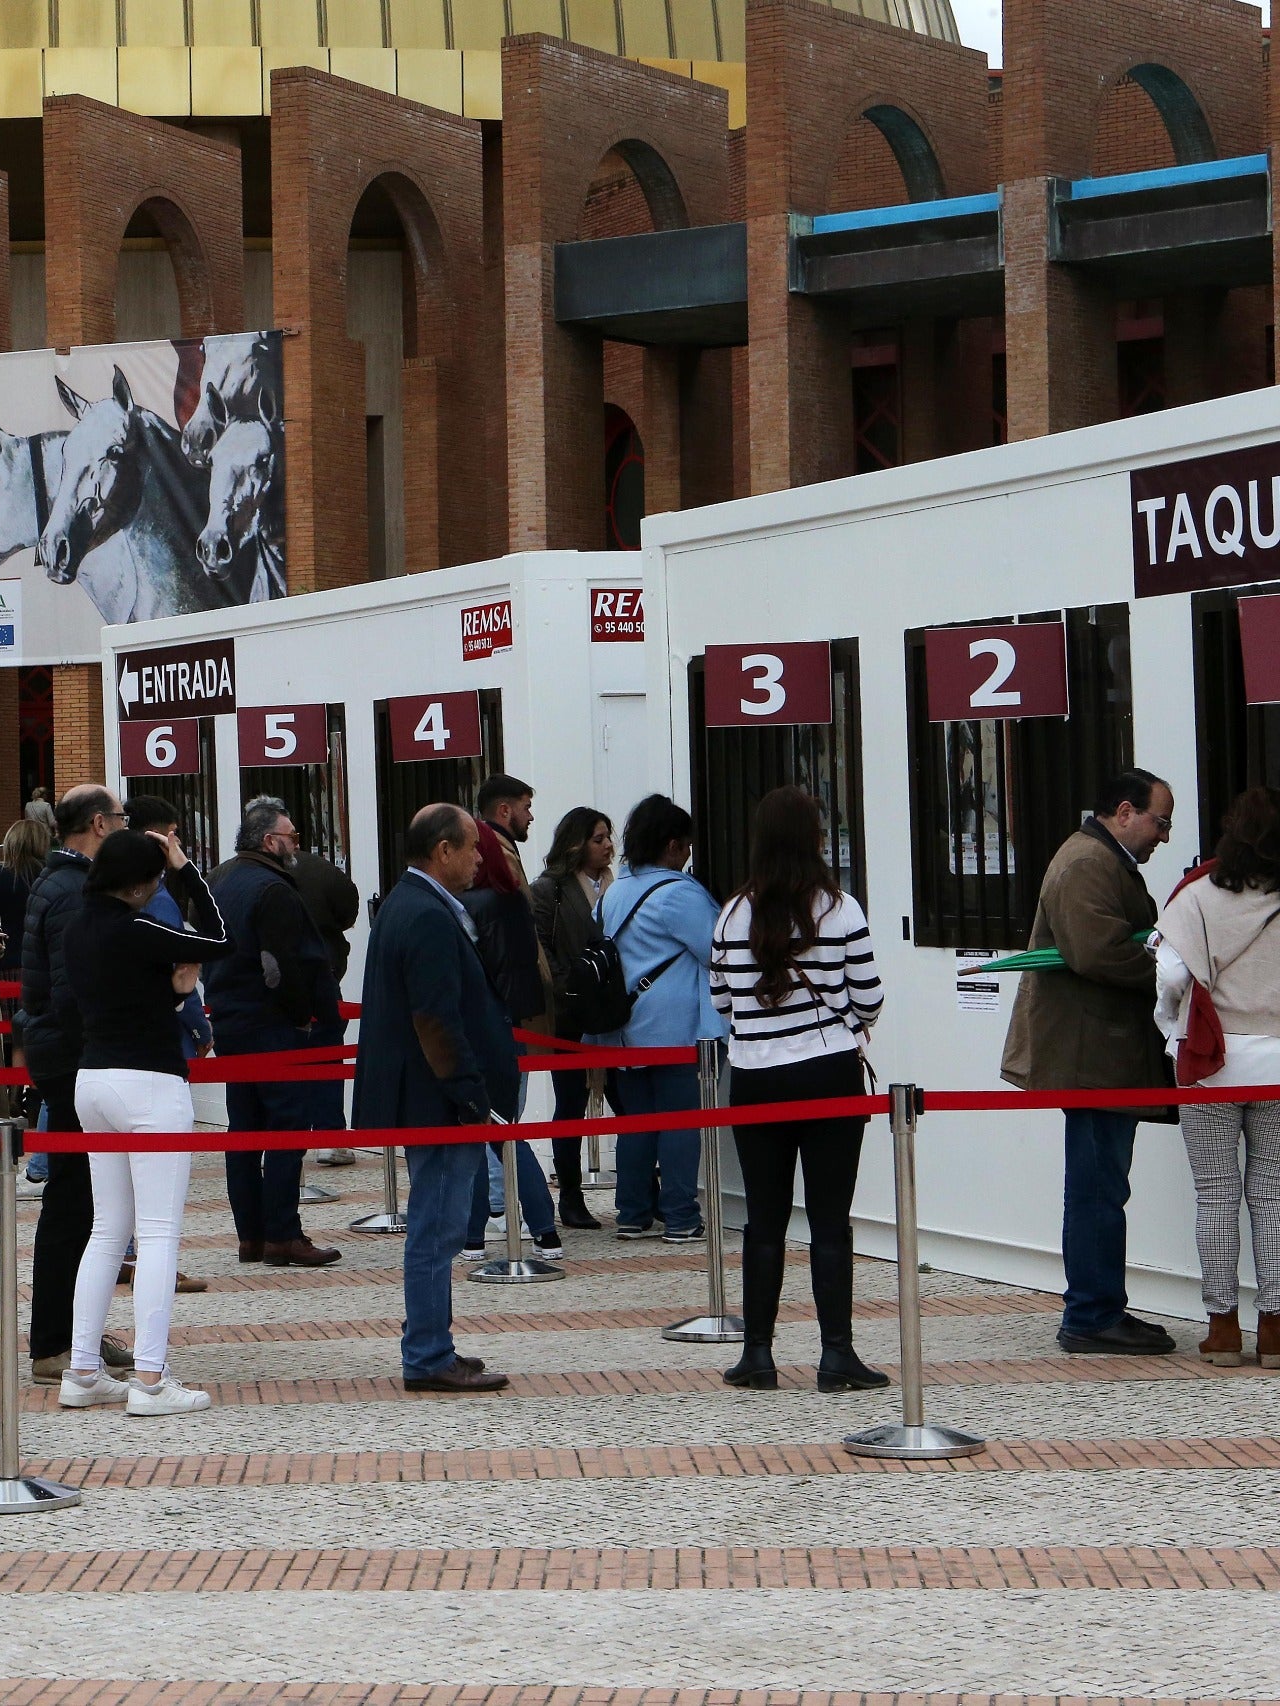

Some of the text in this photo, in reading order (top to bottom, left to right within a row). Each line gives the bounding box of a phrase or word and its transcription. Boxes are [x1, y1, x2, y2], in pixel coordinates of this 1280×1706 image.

[1136, 474, 1280, 565] TAQU
[463, 604, 511, 637] REMSA
[605, 621, 616, 633] 95
[617, 621, 634, 633] 440
[142, 656, 234, 705] ENTRADA
[739, 653, 786, 717] 3
[967, 637, 1022, 709] 2
[144, 725, 177, 769] 6
[264, 713, 298, 759] 5
[413, 701, 452, 752] 4
